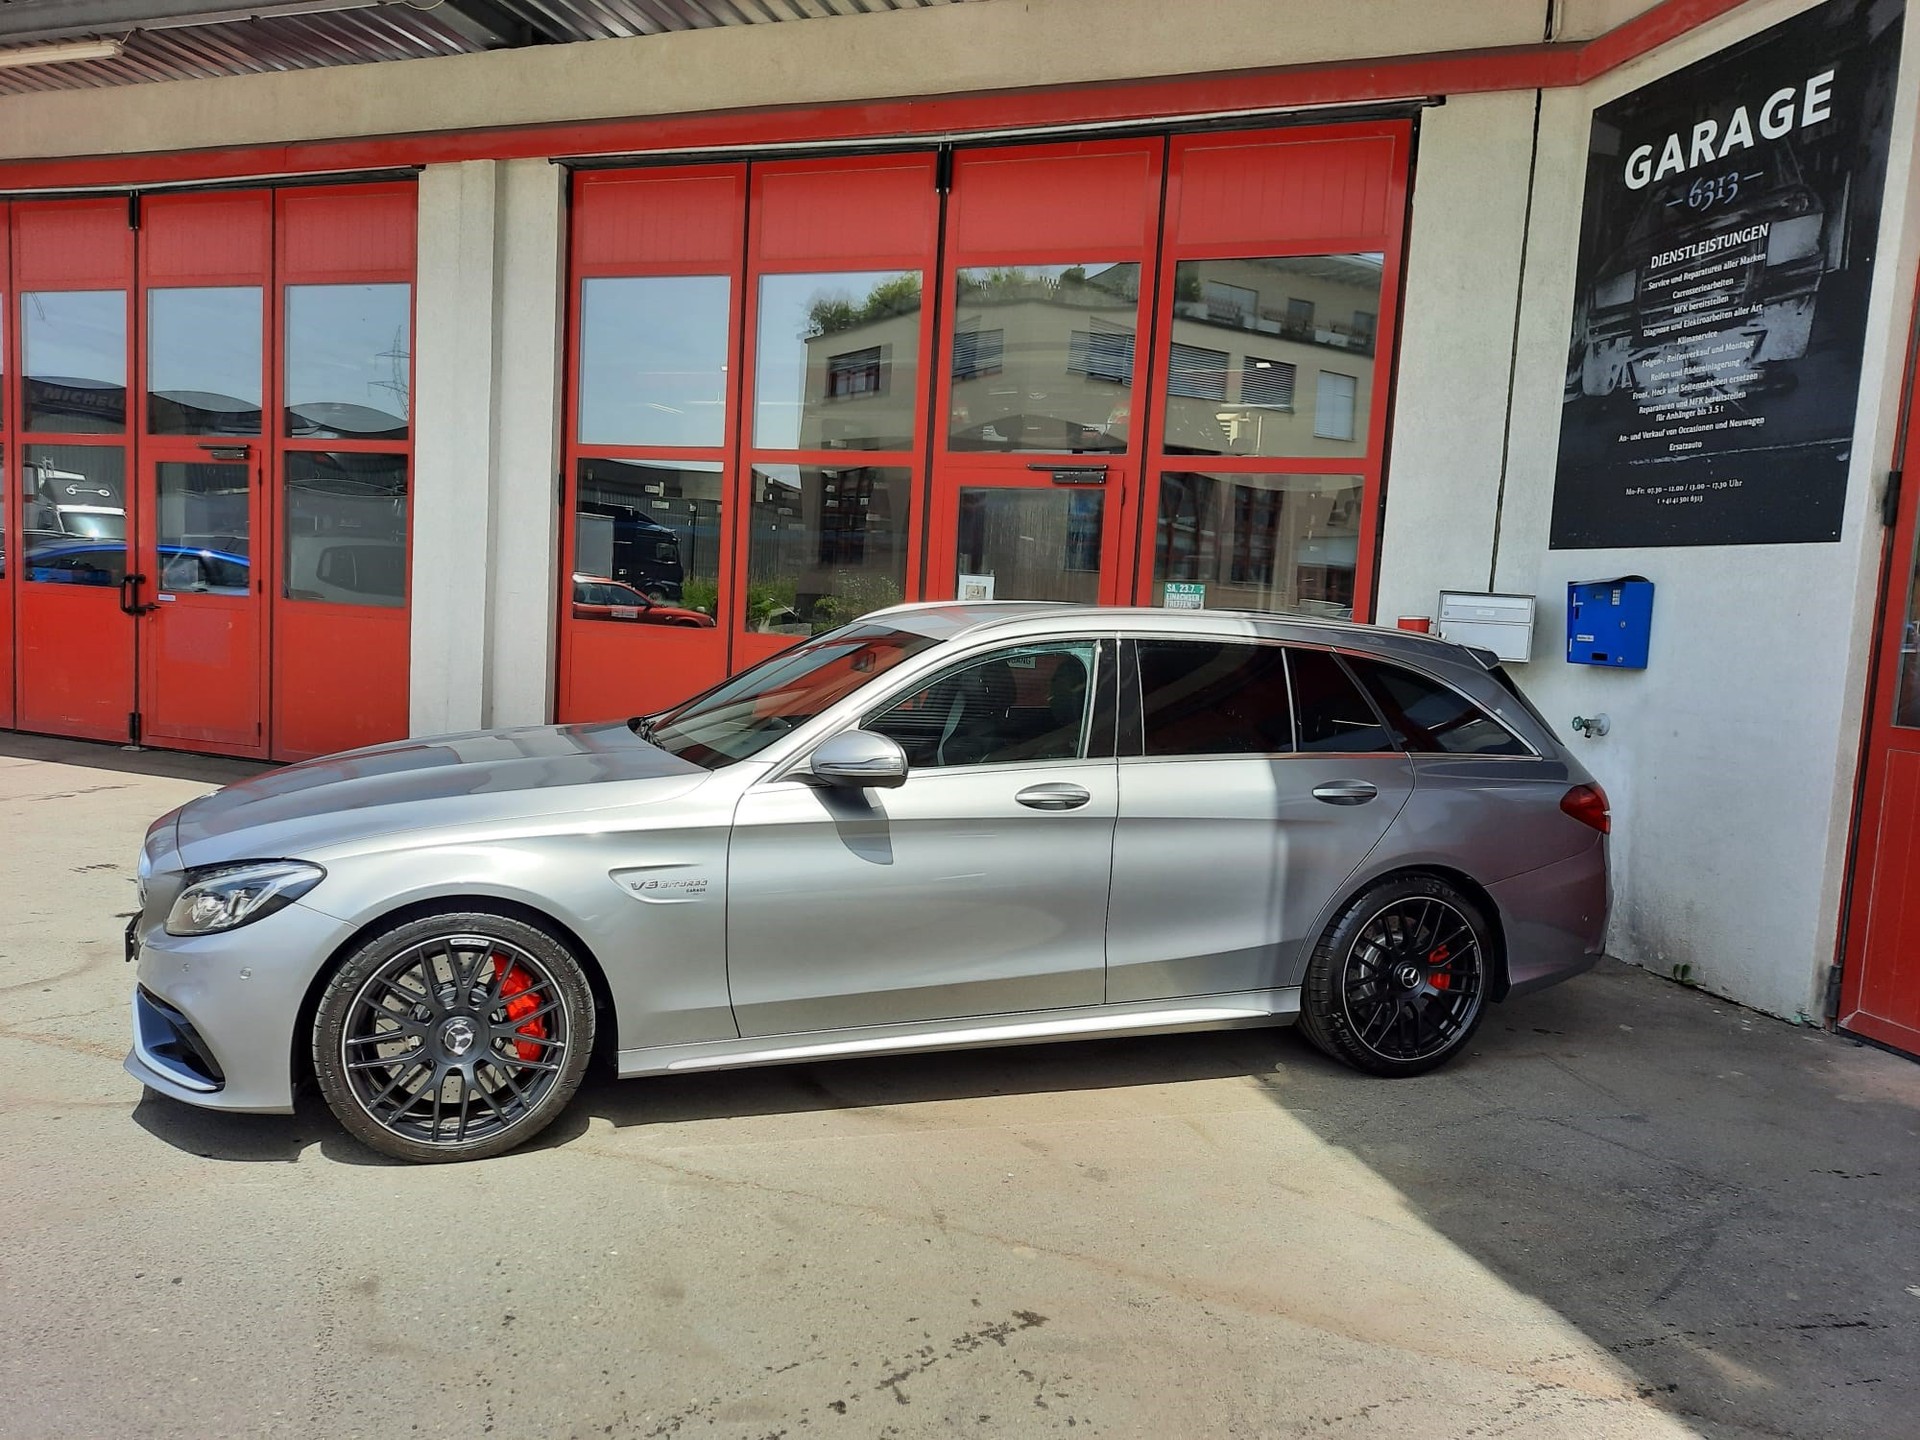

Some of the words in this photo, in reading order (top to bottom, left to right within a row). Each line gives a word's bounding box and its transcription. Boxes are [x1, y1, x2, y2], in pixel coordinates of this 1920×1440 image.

[1624, 69, 1835, 190] GARAGE
[1688, 171, 1739, 211] 6313
[1651, 222, 1769, 269] DIENSTLEISTUNGEN
[1648, 279, 1670, 290] Service
[1671, 274, 1682, 284] und
[1684, 264, 1722, 280] Reparaturen
[1723, 260, 1739, 270] aller
[1740, 253, 1766, 265] Marken
[1673, 278, 1734, 299] Carrosseriearbeiten
[1674, 304, 1688, 314] MFK
[1689, 295, 1729, 310] bereitstellen
[1643, 325, 1670, 337] Diagnose
[1671, 321, 1682, 330] und
[1684, 311, 1733, 328] Elektroarbeiten
[1734, 306, 1749, 317] aller
[1751, 304, 1763, 313] Art
[1678, 330, 1718, 345] Klimaservice
[1667, 346, 1710, 362] Reifenverkauf
[1712, 344, 1724, 354] und
[1725, 340, 1754, 352] Montage
[1651, 371, 1670, 381] Reifen
[1671, 368, 1682, 377] und
[43, 387, 124, 408] MICHEL
[1652, 387, 1666, 397] Heck
[1668, 385, 1680, 393] und
[1639, 403, 1675, 414] Reparaturen
[1676, 400, 1688, 408] und
[1689, 396, 1704, 406] MFK
[1705, 391, 1747, 404] bereitstellen
[1656, 413, 1665, 421] für
[1666, 410, 1696, 419] Anhänger
[1697, 407, 1707, 415] bis
[1619, 434, 1629, 442] An-
[1630, 432, 1641, 441] und
[1642, 429, 1666, 439] Verkauf
[1666, 428, 1677, 436] von
[1678, 424, 1714, 434] Occasionen
[1715, 420, 1728, 429] und
[1729, 417, 1765, 428] Neuwagen
[1669, 441, 1702, 451] Ersatzauto
[1729, 479, 1743, 487] Uhr
[1167, 583, 1178, 592] SA.
[1179, 584, 1196, 594] 23.7.
[630, 880, 658, 891] V8
[660, 879, 708, 889] BITURBO
